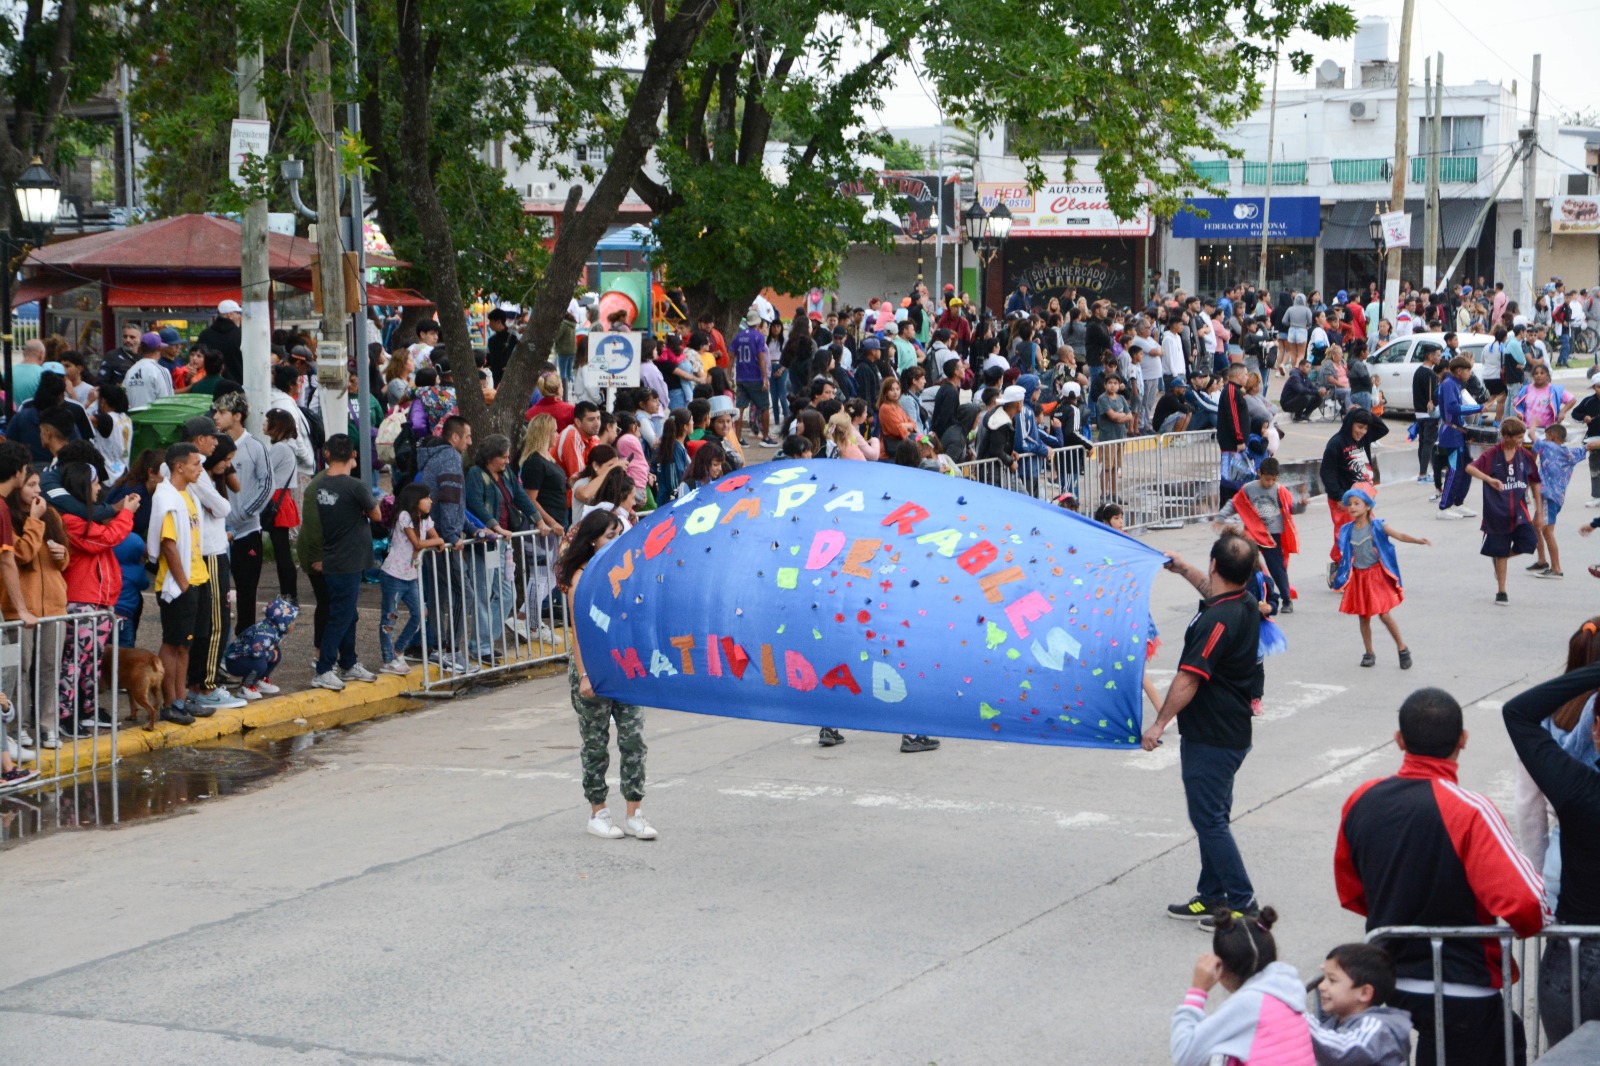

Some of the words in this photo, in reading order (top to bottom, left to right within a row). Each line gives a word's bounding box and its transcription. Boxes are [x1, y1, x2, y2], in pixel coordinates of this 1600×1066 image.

[993, 188, 1023, 199] RED
[1048, 185, 1108, 194] AUTOSER
[1204, 222, 1249, 230] FEDERACION
[1250, 222, 1288, 230] PATONAL
[1031, 265, 1107, 281] SUPERMERCADO
[1035, 275, 1102, 291] CLAUDIO
[738, 345, 751, 363] 10
[1508, 464, 1514, 475] 5
[805, 529, 883, 579] DE
[611, 633, 908, 704] NATIVIDAD
